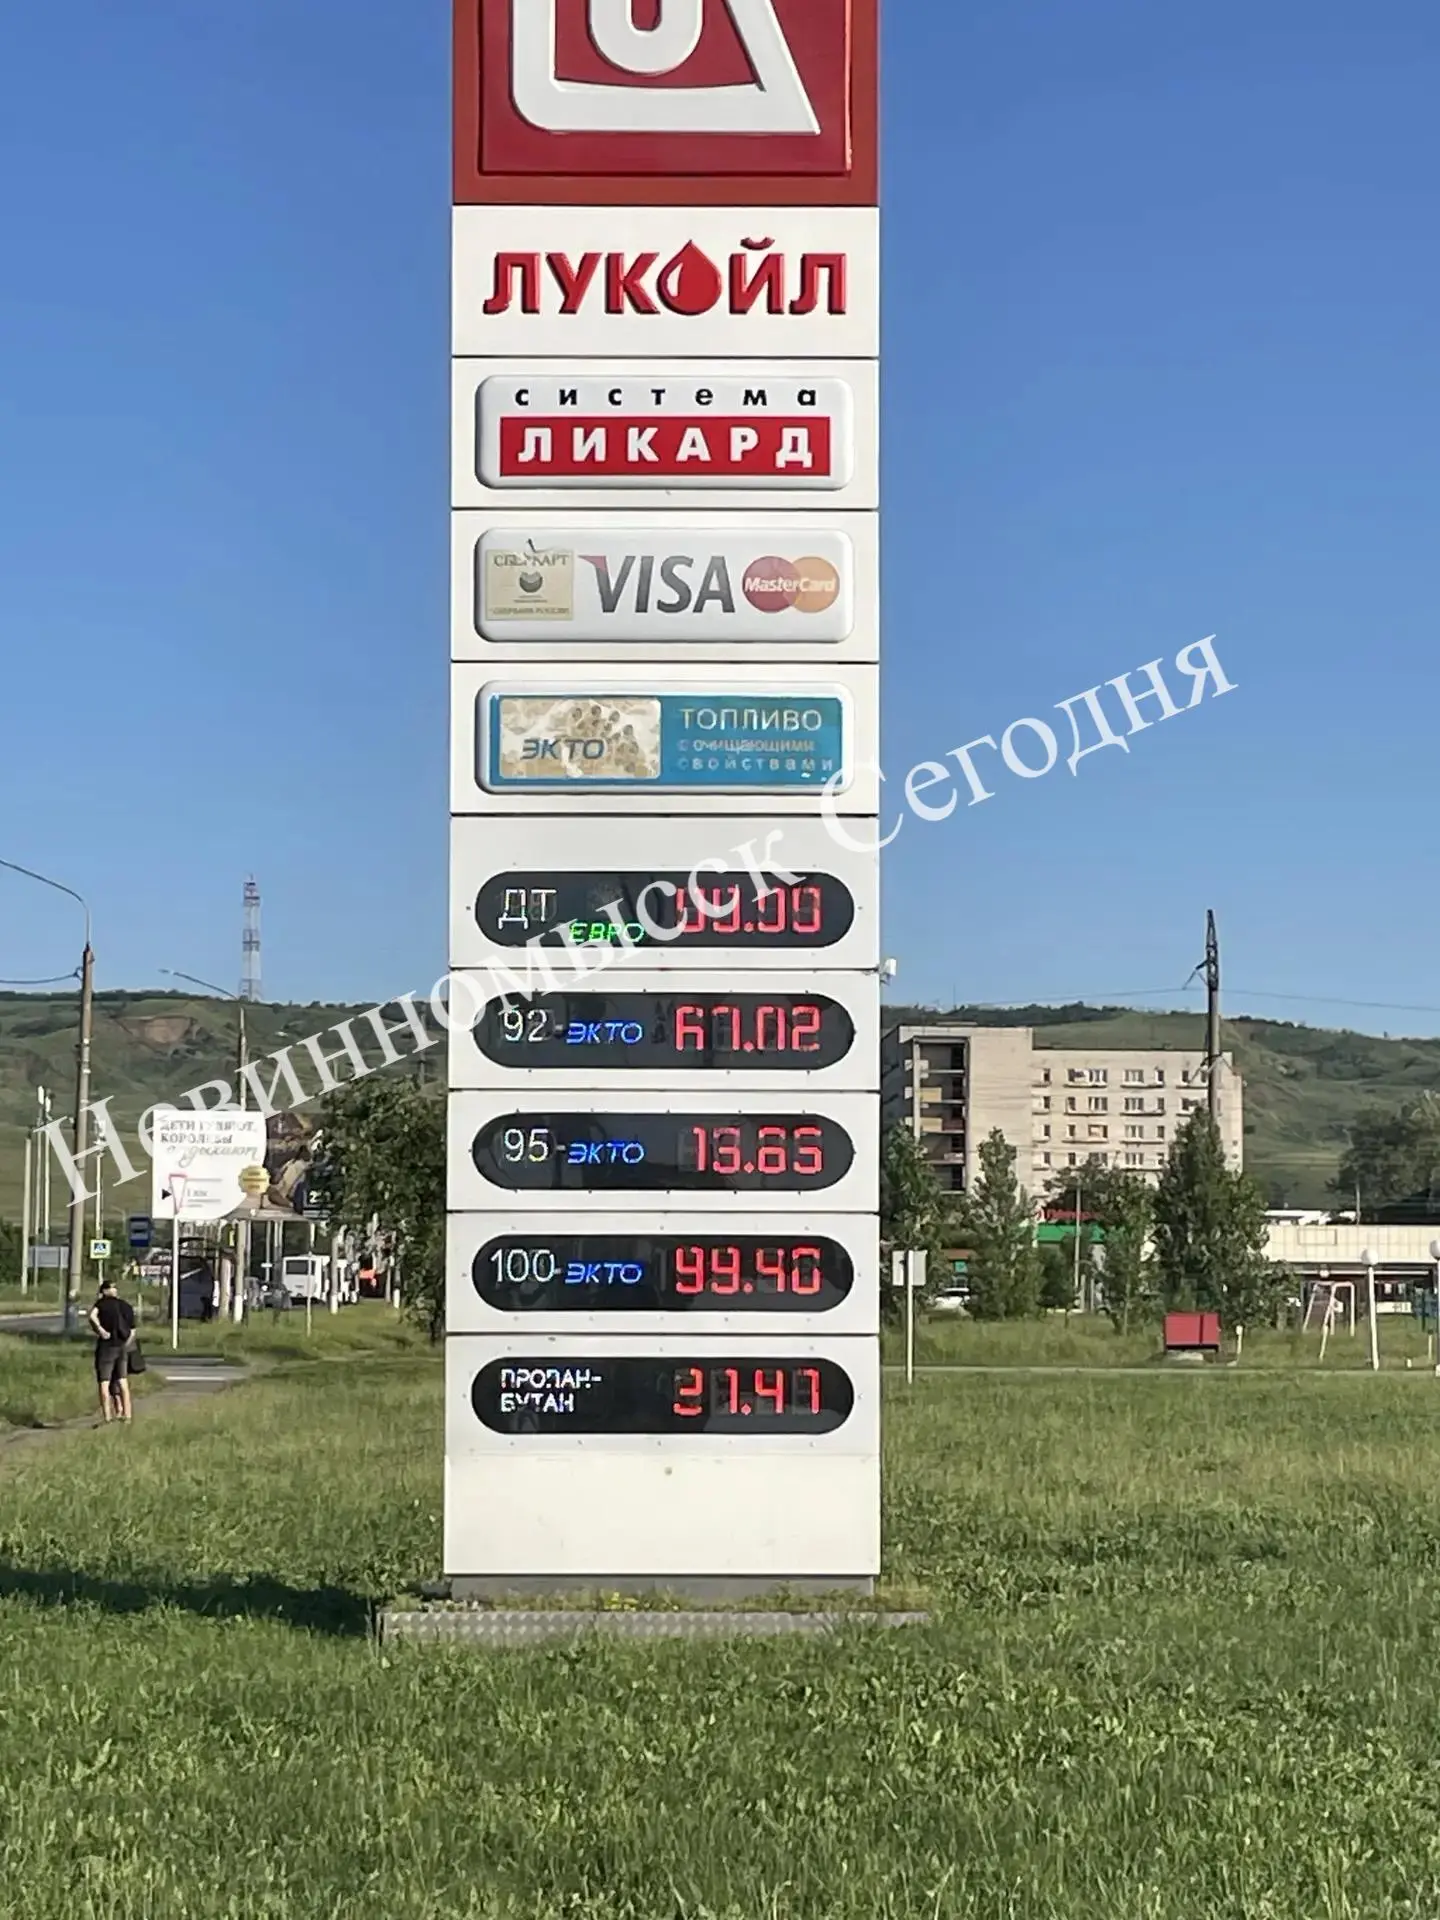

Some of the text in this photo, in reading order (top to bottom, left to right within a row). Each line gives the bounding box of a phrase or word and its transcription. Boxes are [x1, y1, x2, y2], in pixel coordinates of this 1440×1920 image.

[483, 236, 847, 316] ЛУКОЙЛ
[514, 387, 817, 407] система
[517, 426, 814, 468] ЛИКАРД
[577, 554, 736, 614] VISA
[744, 577, 837, 593] MasterCard
[680, 707, 823, 732] ТОПЛИВО
[520, 738, 605, 761] ЭКТО
[498, 888, 558, 930] ДТ
[568, 922, 645, 943] ЕВРО
[501, 1392, 576, 1413] БУТАН
